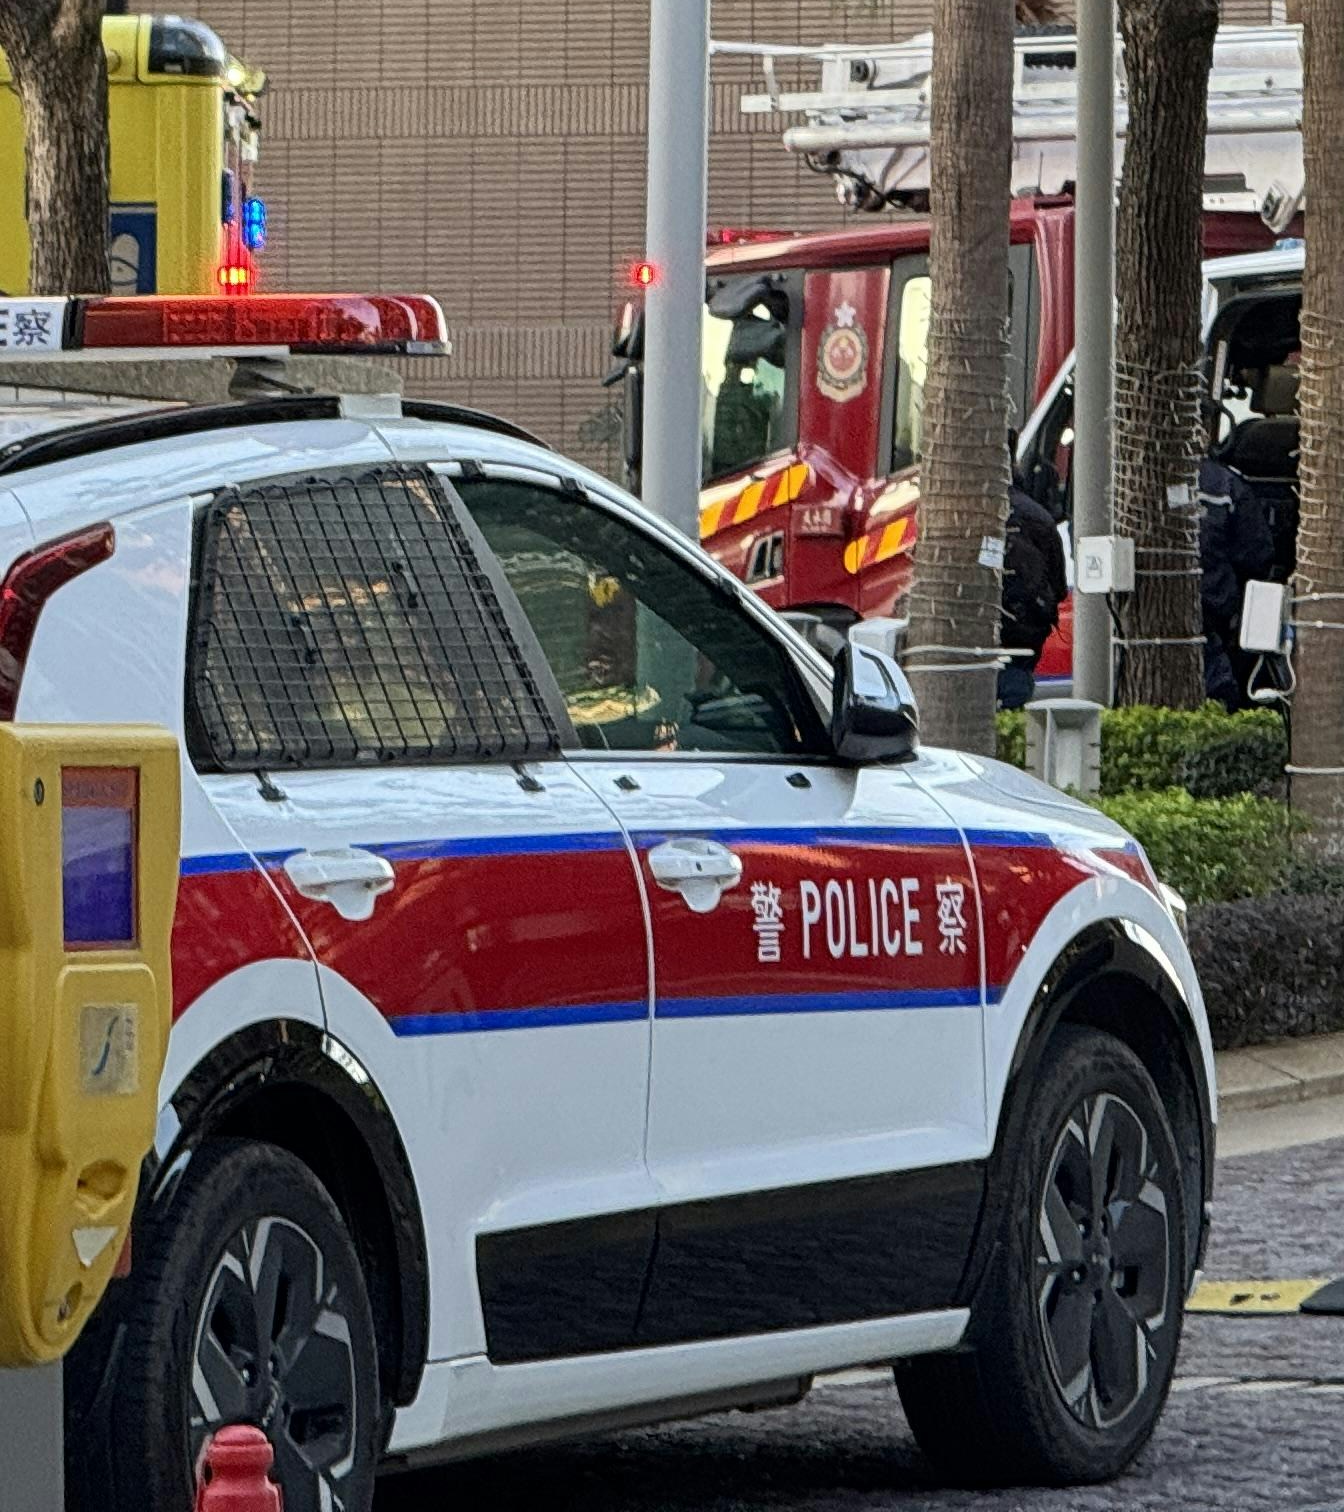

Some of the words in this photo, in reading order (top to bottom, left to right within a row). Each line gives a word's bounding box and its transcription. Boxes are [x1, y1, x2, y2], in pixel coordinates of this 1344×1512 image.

[13, 309, 51, 345] 察
[750, 880, 785, 963] 警
[800, 877, 923, 960] POLICE
[935, 875, 967, 955] 察
